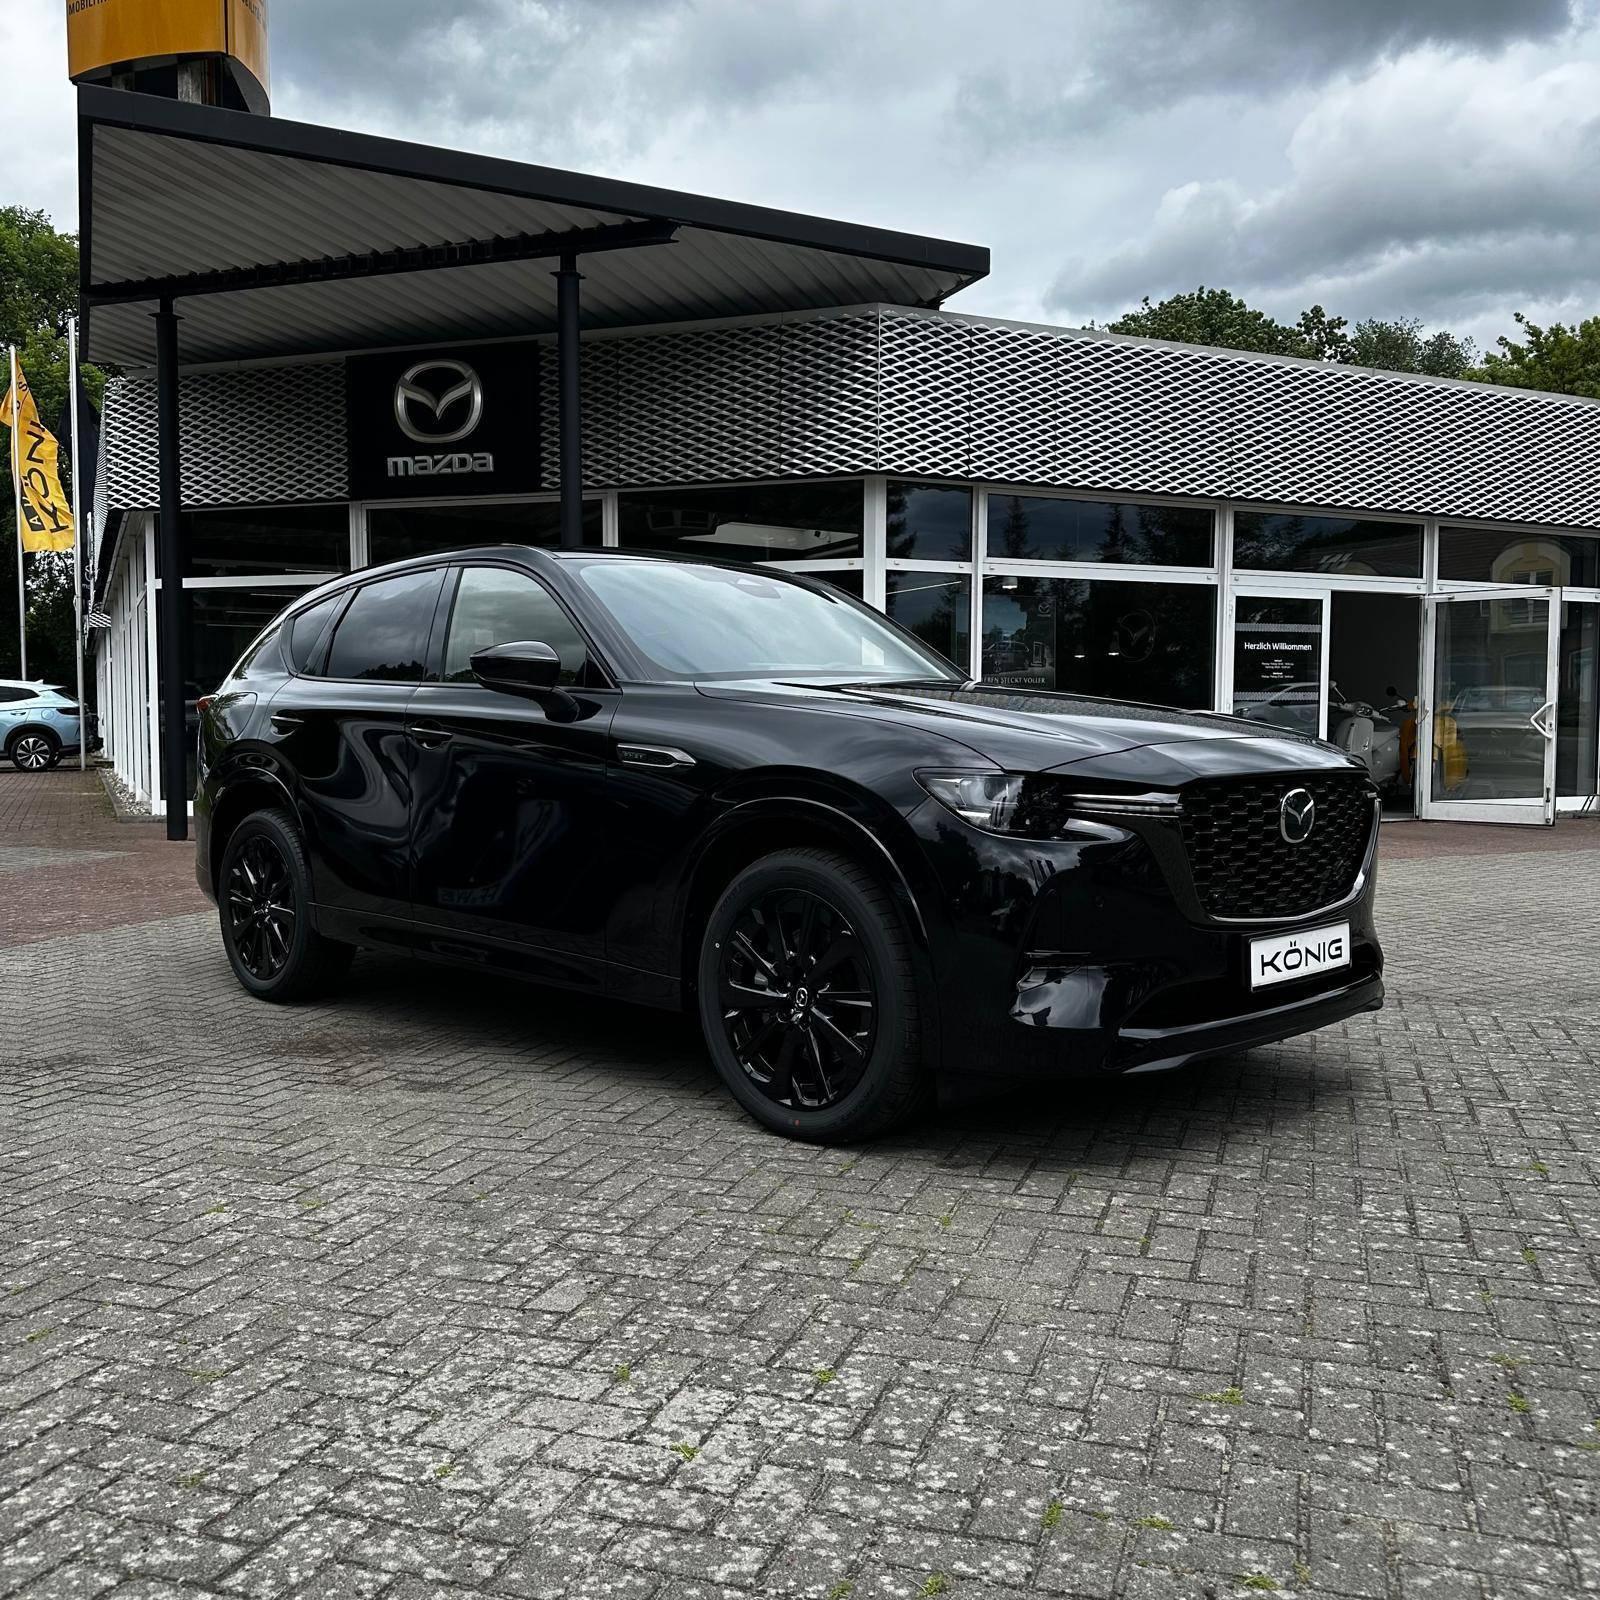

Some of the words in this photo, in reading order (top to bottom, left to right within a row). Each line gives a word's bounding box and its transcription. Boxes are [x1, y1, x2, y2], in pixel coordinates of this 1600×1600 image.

[1244, 642, 1271, 651] Herzlich
[1272, 642, 1312, 651] Willkommen
[1261, 938, 1343, 976] KÖNIG
